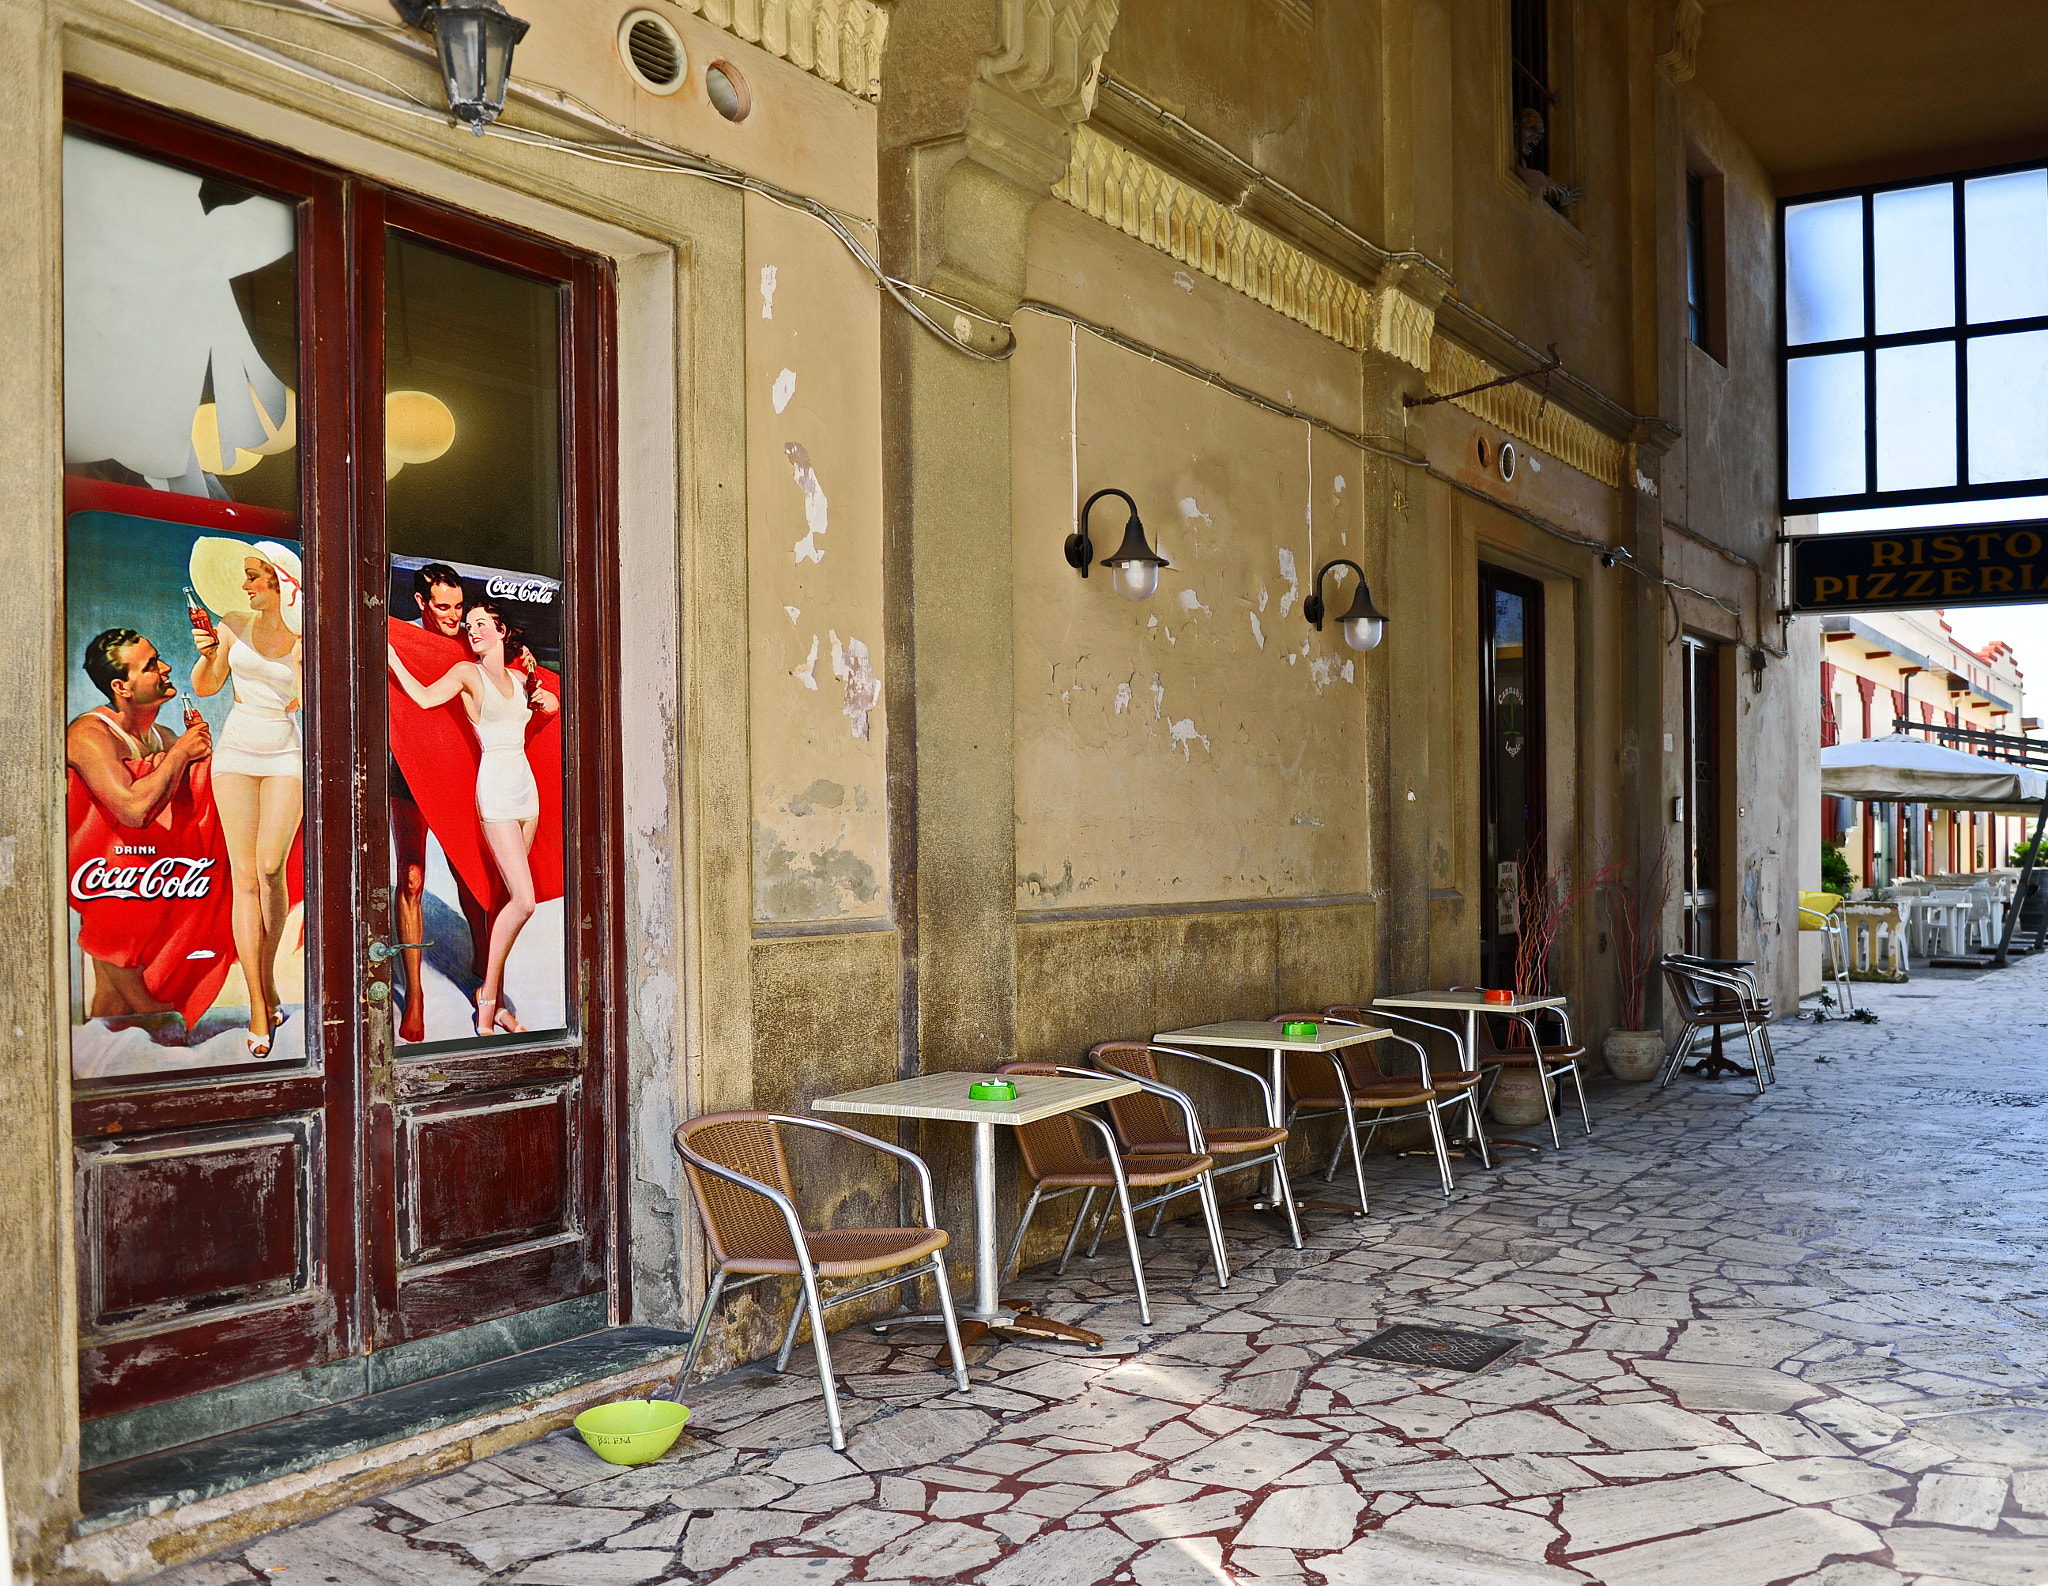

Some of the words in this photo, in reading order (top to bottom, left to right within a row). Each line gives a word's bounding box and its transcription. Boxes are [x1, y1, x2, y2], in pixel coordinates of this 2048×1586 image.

[1870, 530, 2048, 567] RISTO
[485, 575, 556, 604] Coca-Cola
[113, 845, 156, 855] DRINK
[70, 857, 216, 900] Coca-Cola
